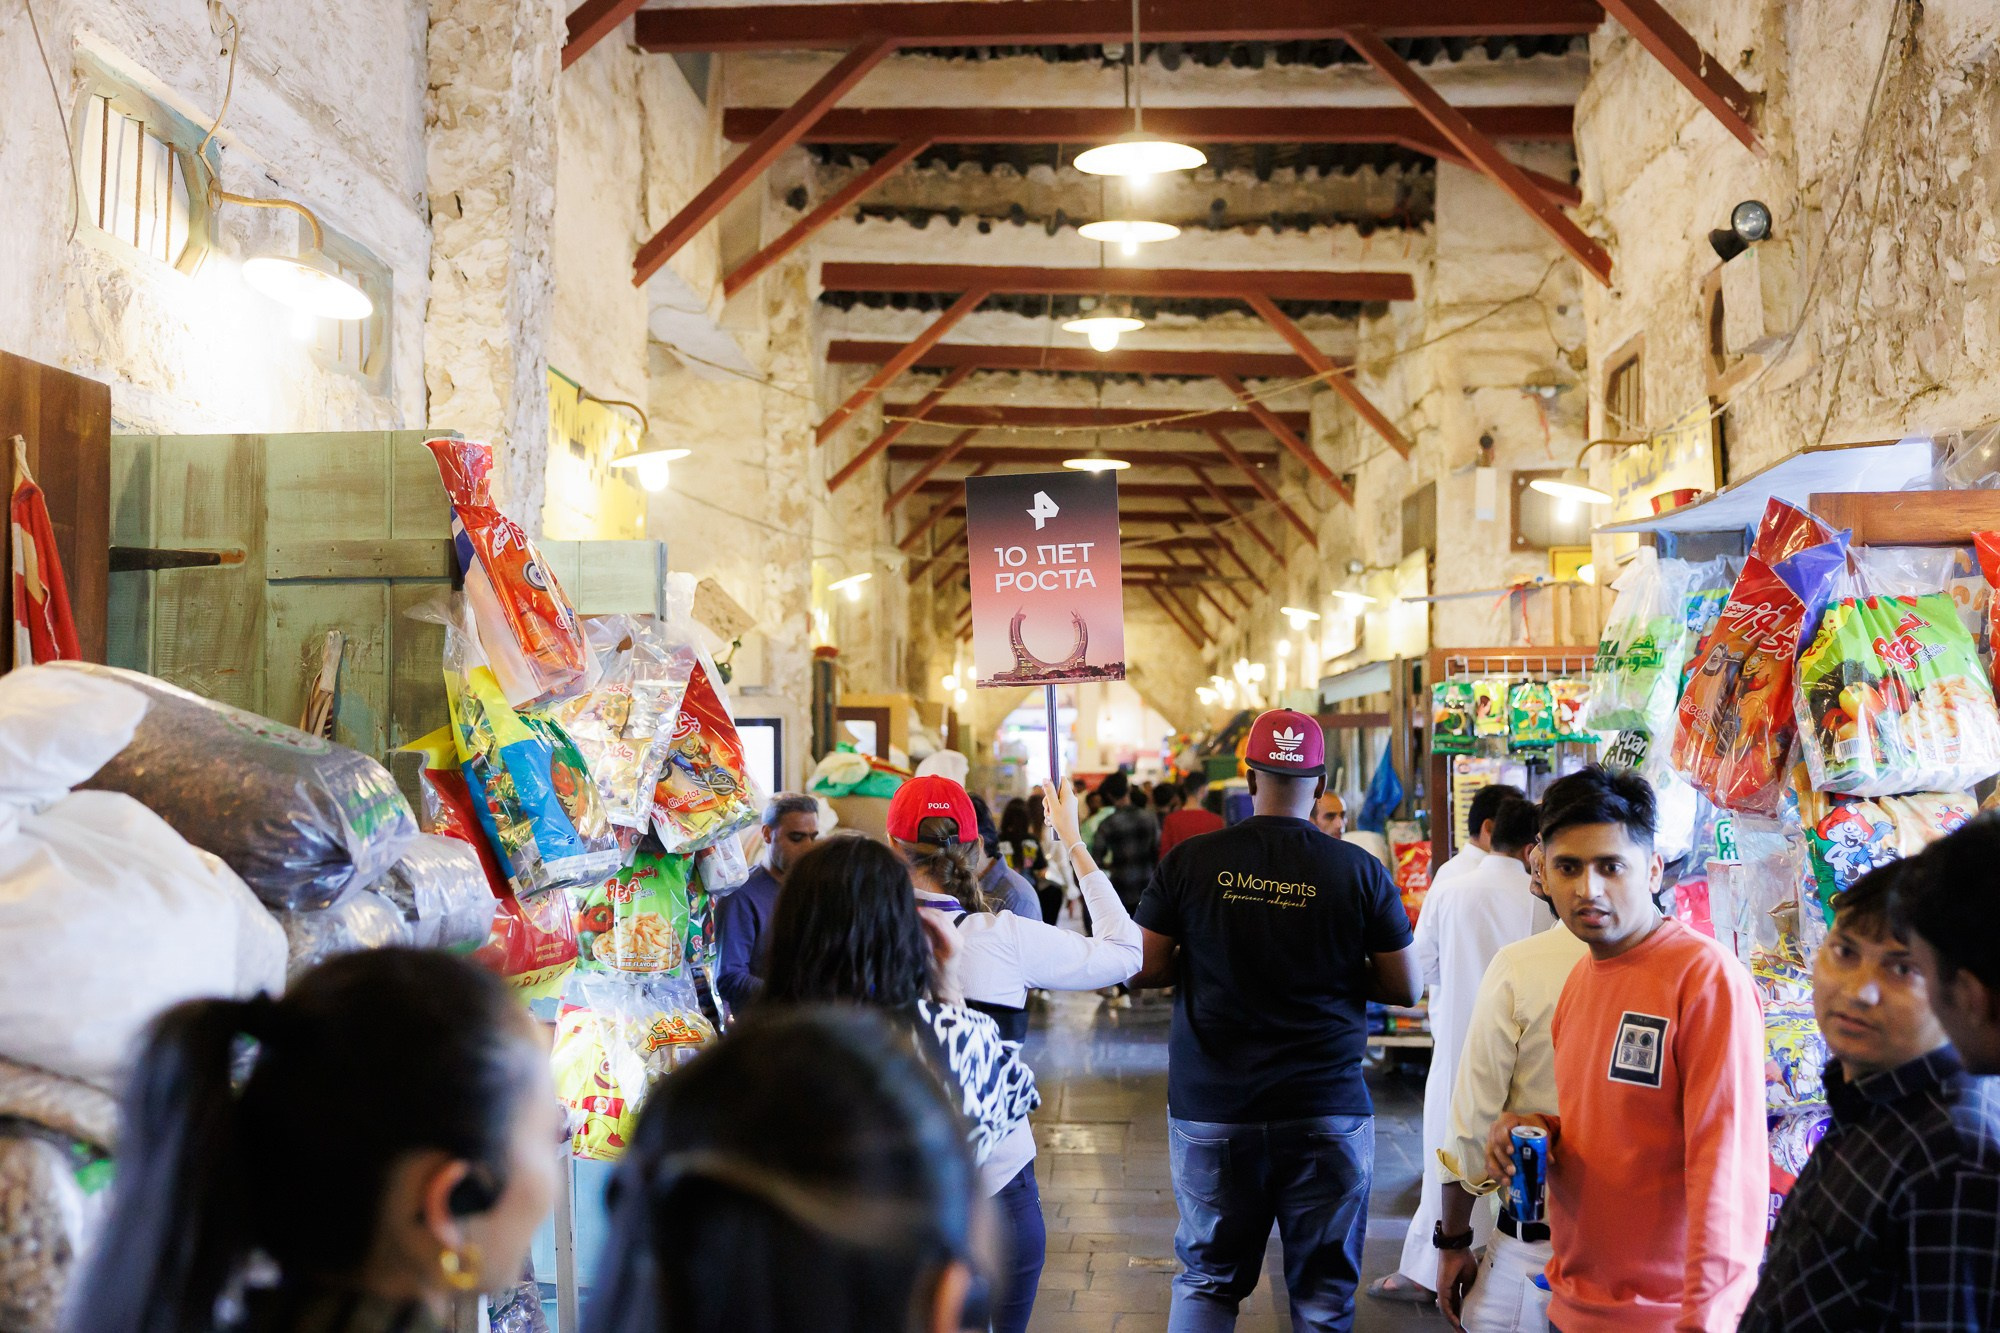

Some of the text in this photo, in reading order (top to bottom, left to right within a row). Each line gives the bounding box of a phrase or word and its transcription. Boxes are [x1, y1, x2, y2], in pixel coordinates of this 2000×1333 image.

[994, 542, 1095, 567] 10 ЛЕТ
[995, 568, 1097, 593] РОСТА
[1268, 751, 1304, 763] adidas
[667, 788, 701, 810] Cheetoz
[928, 802, 950, 810] POLO
[1217, 871, 1317, 897] Q Moments
[1222, 890, 1307, 909] Experience redefined
